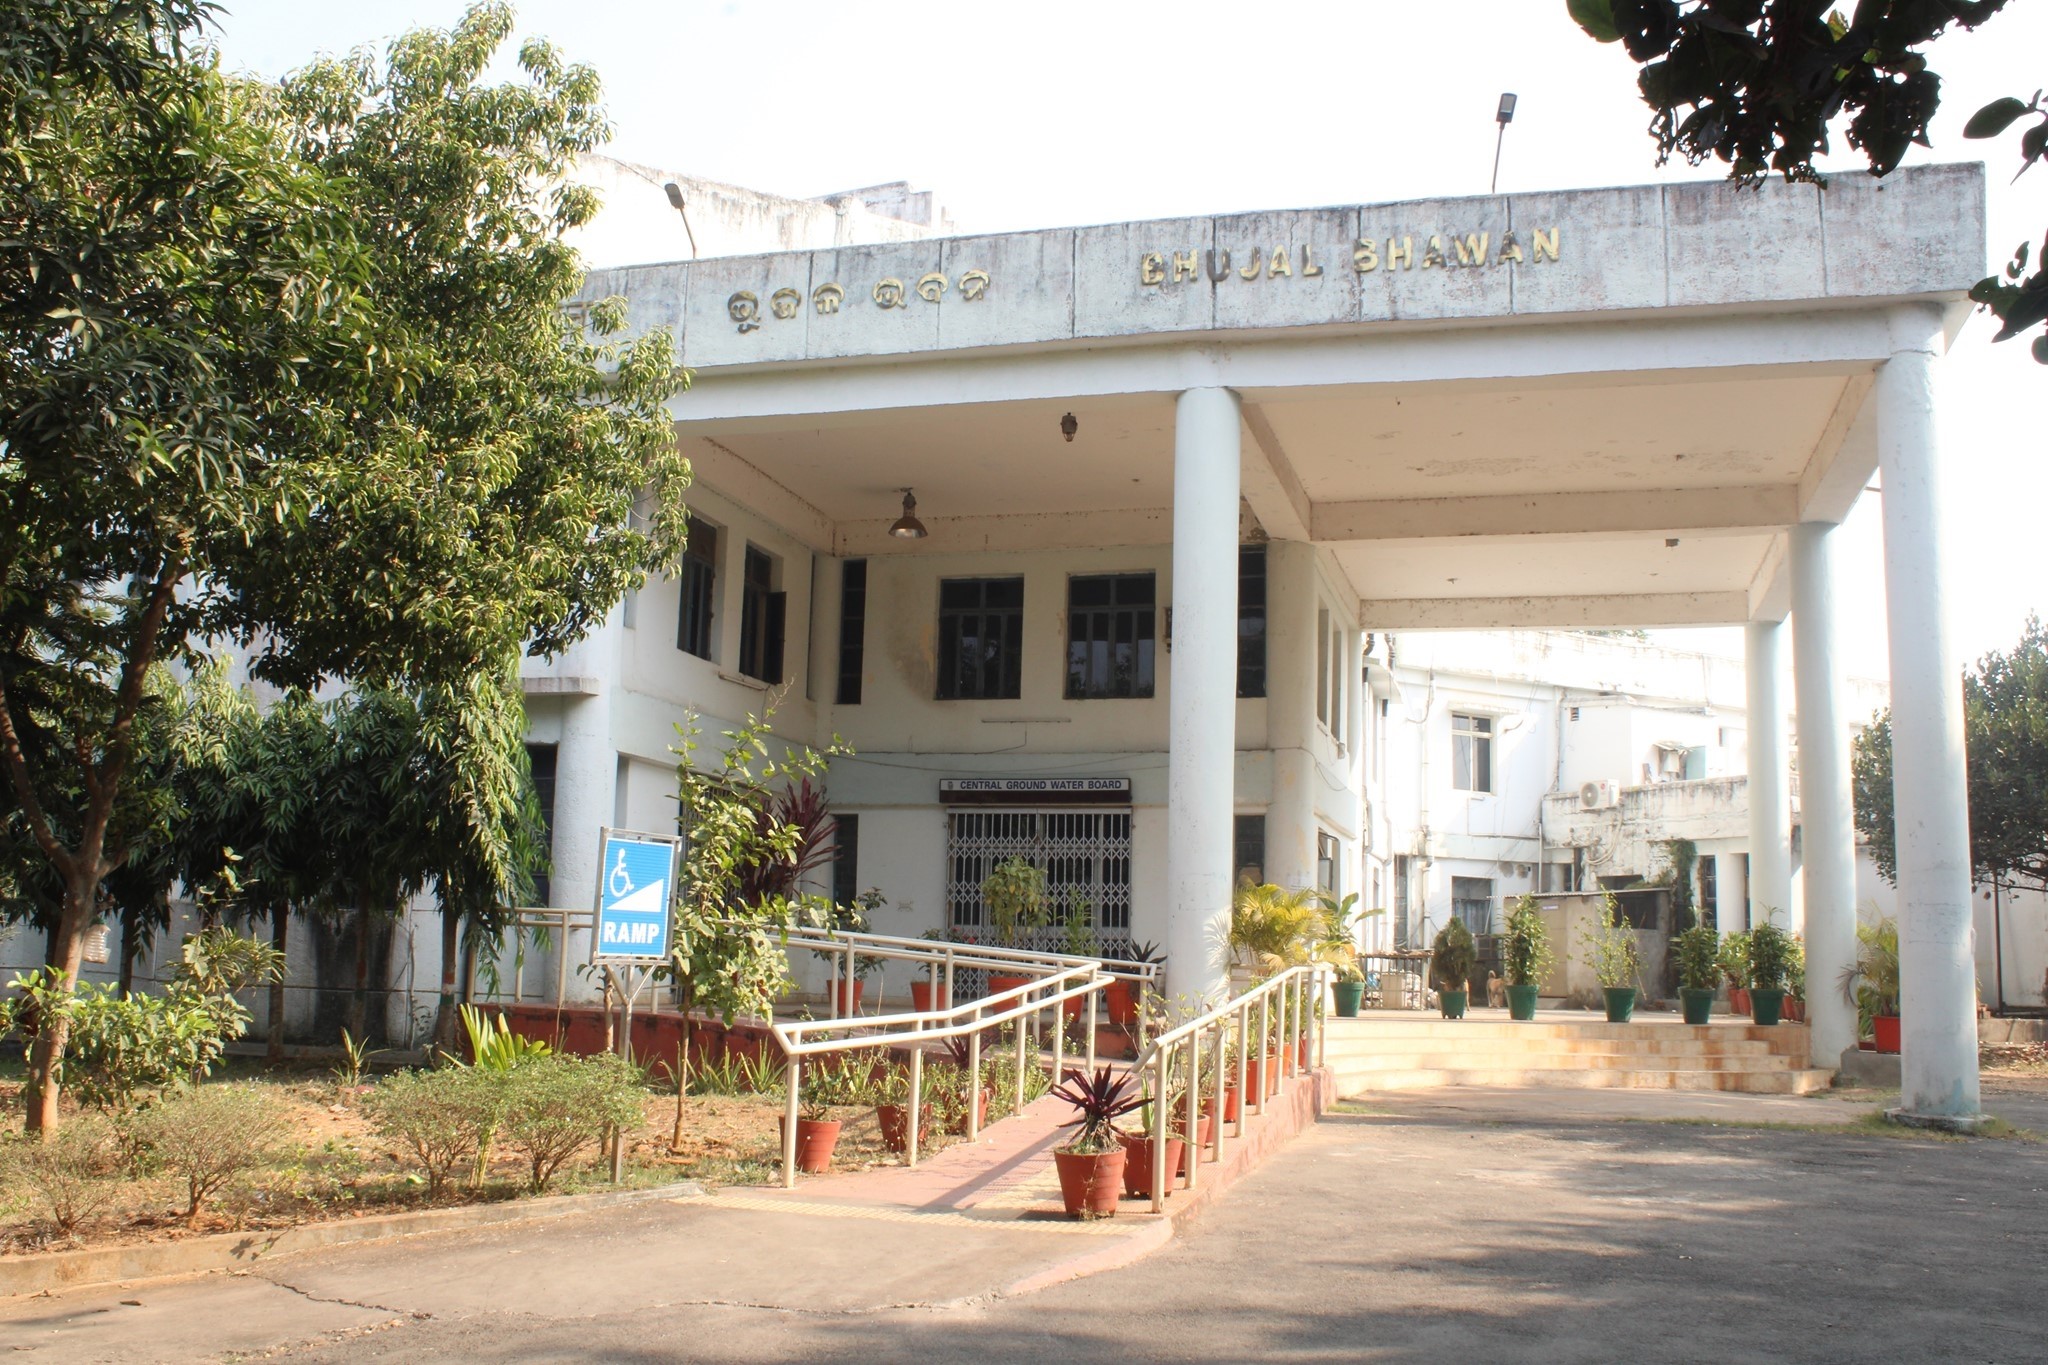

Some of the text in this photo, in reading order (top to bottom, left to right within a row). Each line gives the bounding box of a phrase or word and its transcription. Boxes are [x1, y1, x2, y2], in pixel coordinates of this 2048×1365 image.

[1140, 226, 1560, 286] BHUJAL BHAWAN
[960, 780, 1122, 790] CENTRAL GROUND WATER BOARD
[603, 920, 660, 944] RAMP
